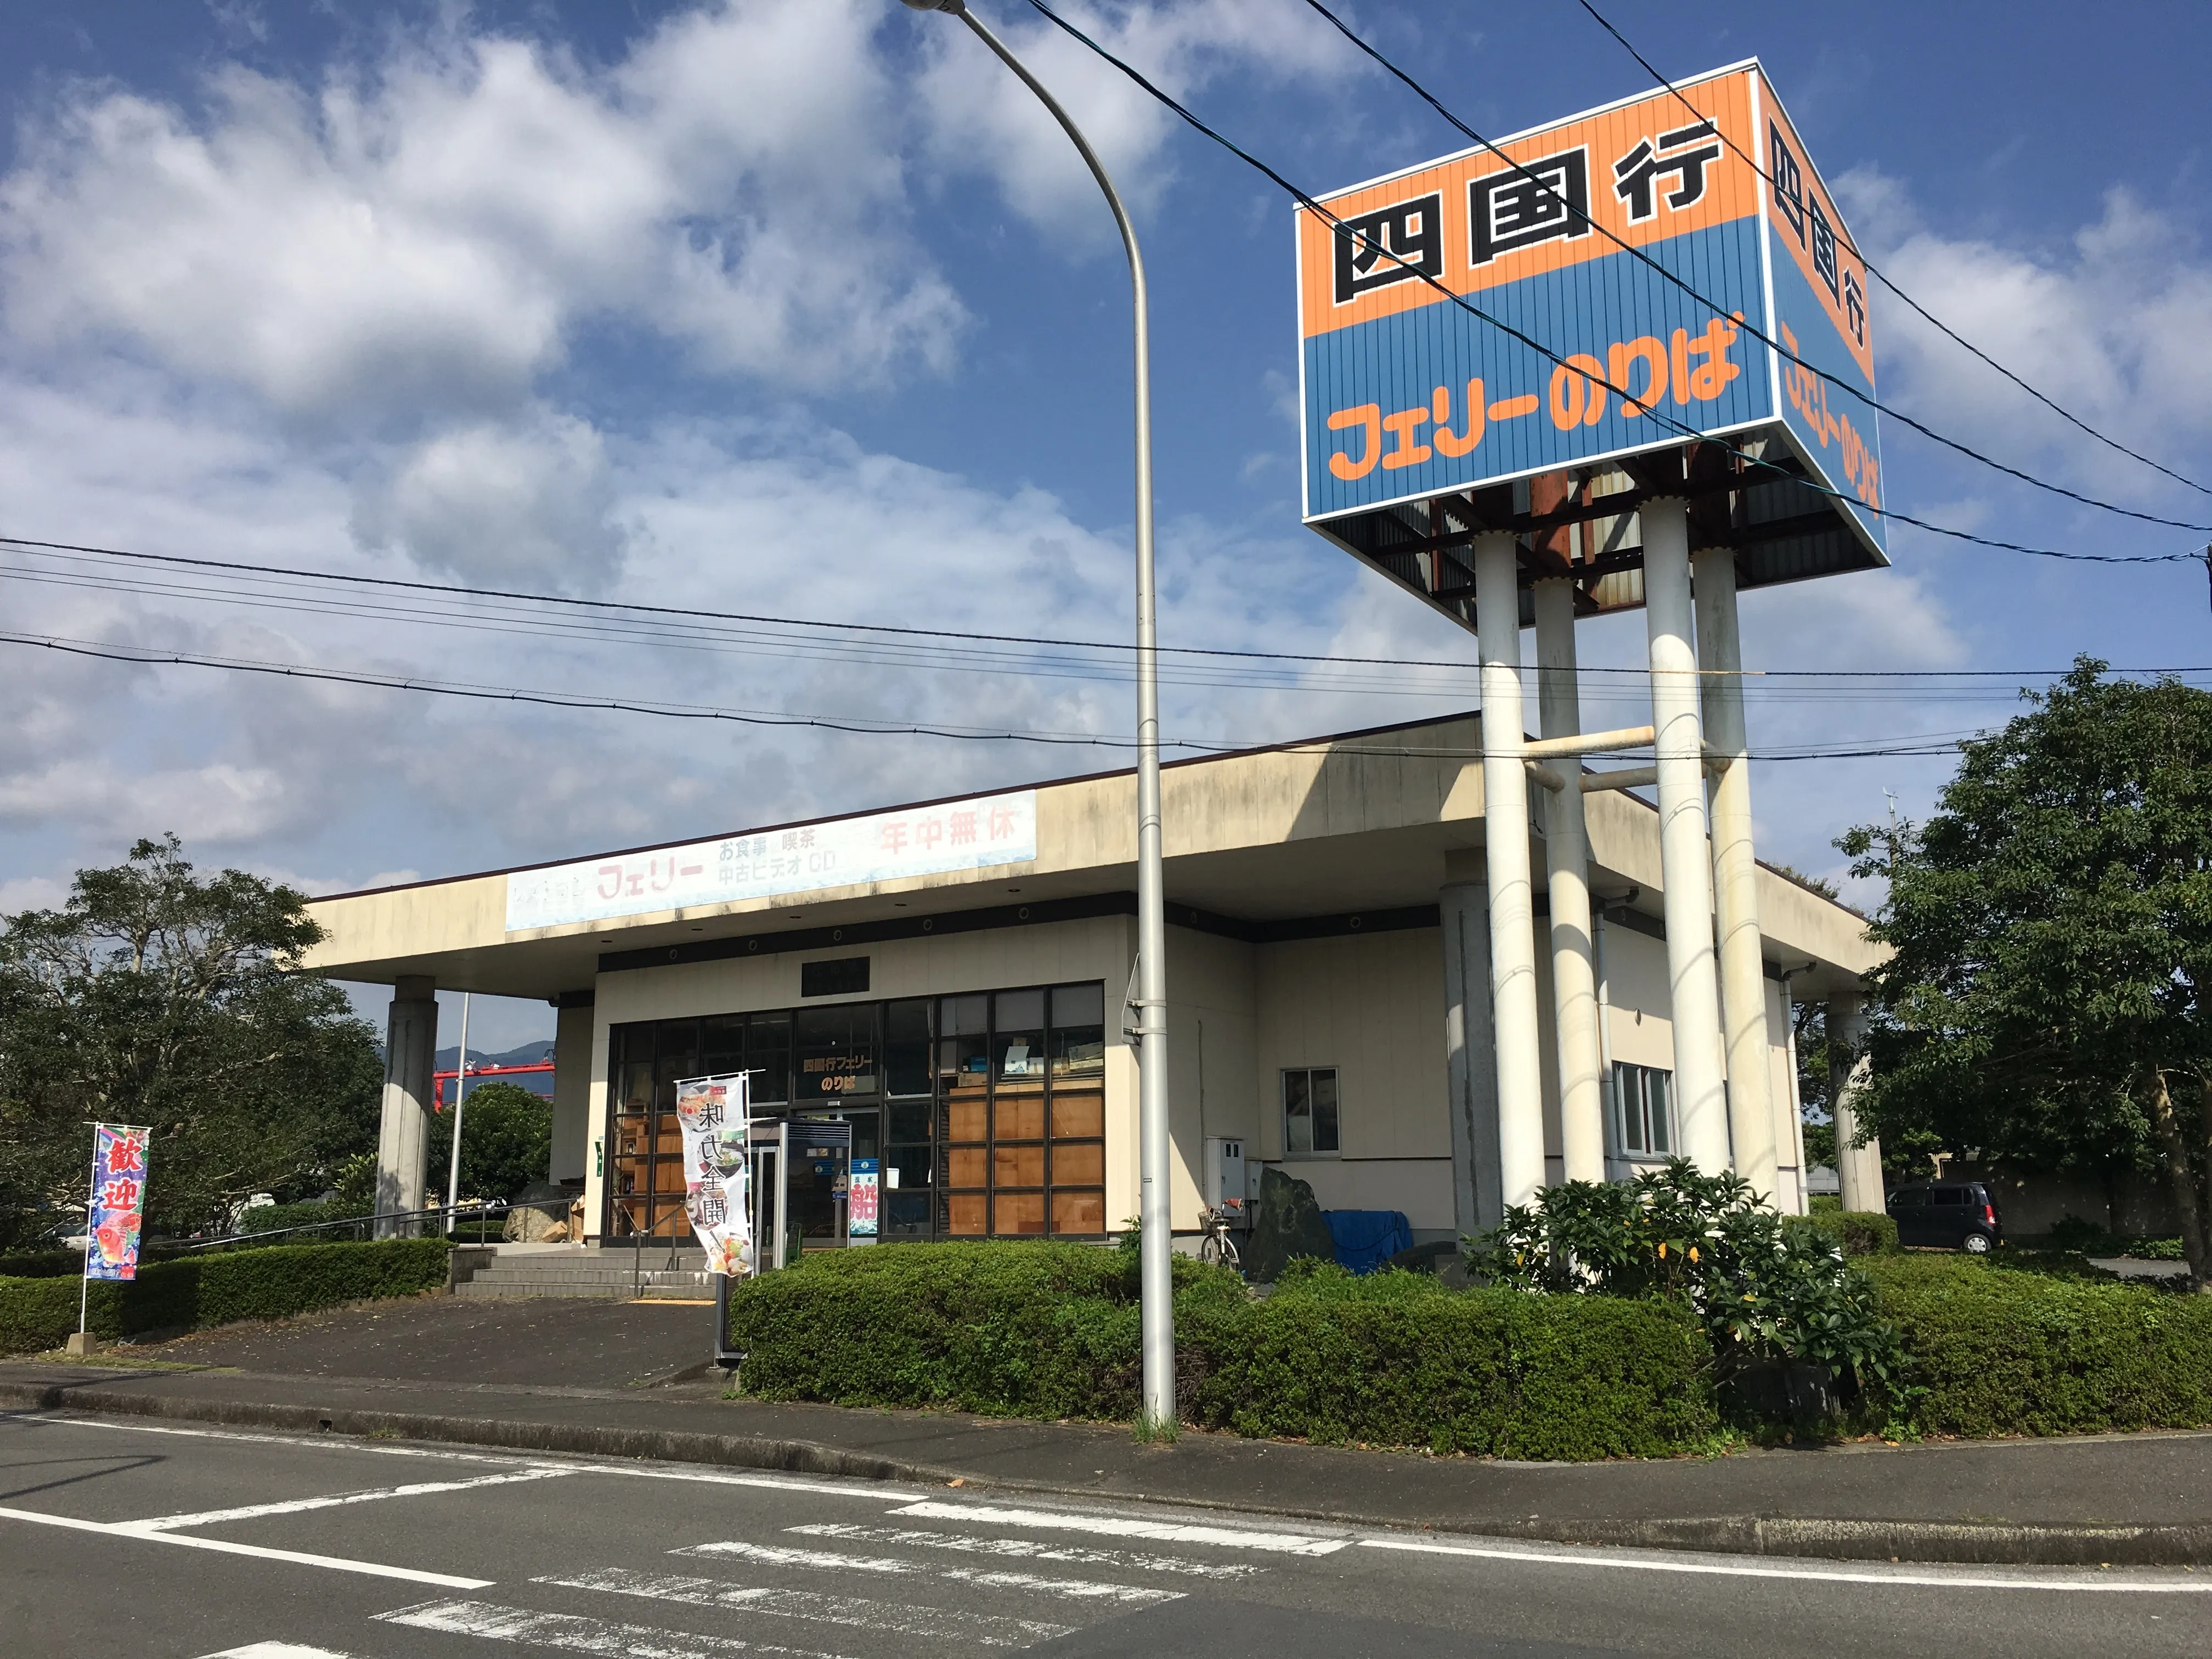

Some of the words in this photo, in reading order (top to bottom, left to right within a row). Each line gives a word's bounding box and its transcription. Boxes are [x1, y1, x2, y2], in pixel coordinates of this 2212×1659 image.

[1334, 117, 1724, 306] 四国行
[1769, 112, 1865, 351] 四国行
[1327, 311, 1746, 481] フェリーのりば
[1781, 320, 1881, 520] フェリーのりば
[719, 836, 768, 861] お食事
[782, 828, 816, 851] 喫茶
[881, 803, 1015, 854] 年中無休
[597, 856, 704, 900] フェリー
[719, 855, 802, 885] 中古ビデオ
[809, 850, 836, 873] CD
[821, 1075, 856, 1091] のりば
[103, 1138, 143, 1211] 歓迎
